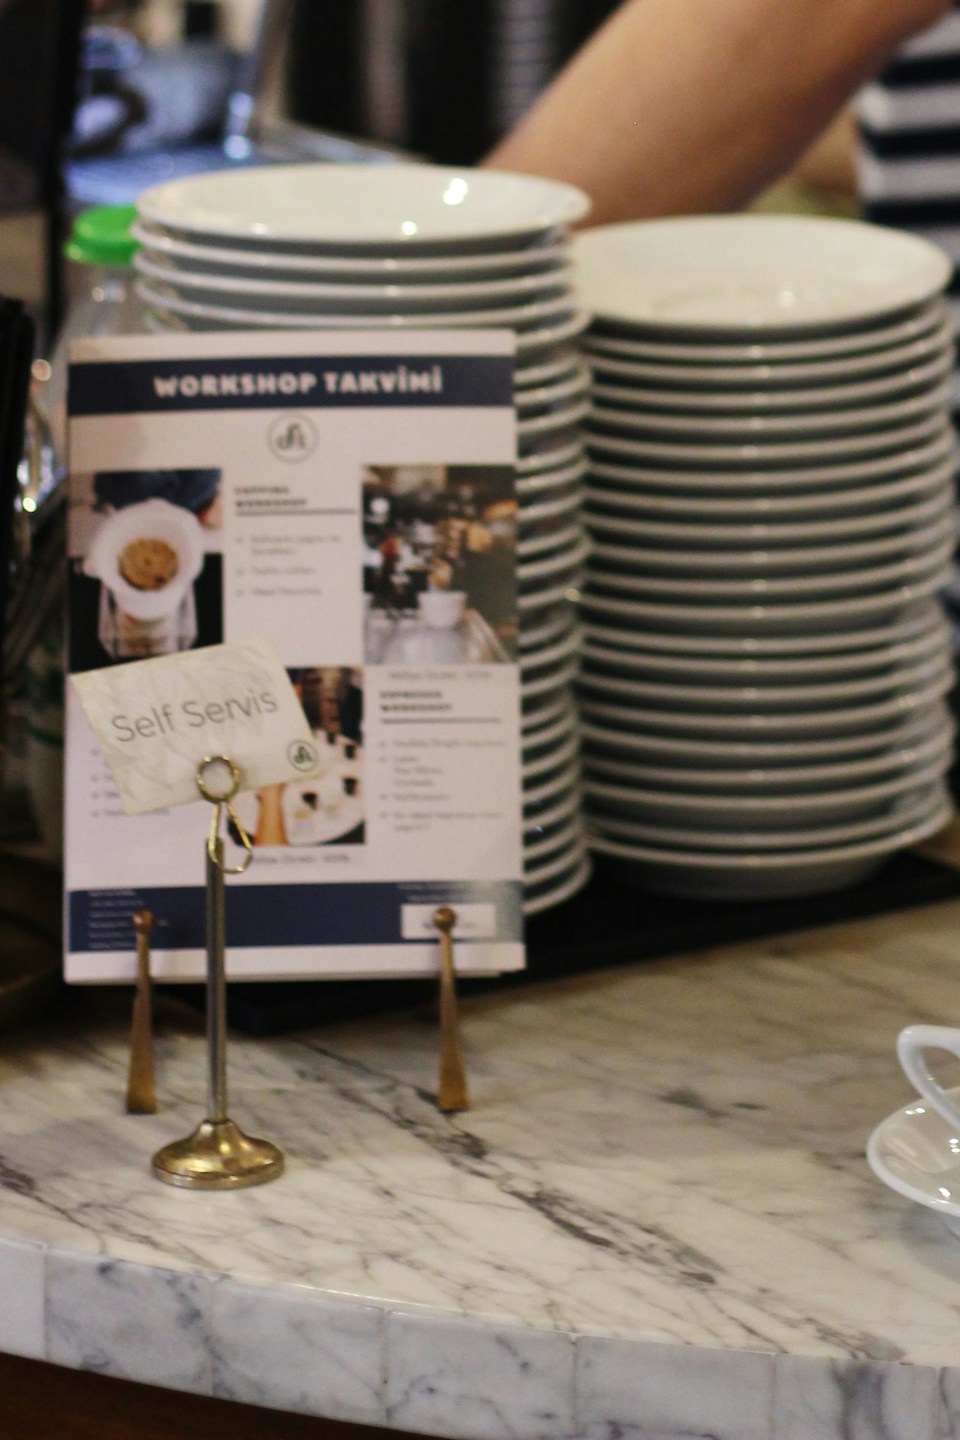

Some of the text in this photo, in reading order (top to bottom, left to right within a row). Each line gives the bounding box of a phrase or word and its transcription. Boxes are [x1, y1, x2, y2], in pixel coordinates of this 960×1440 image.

[153, 364, 443, 398] WORKSHOP TAKVİMİ
[111, 689, 278, 743] Self Servis
